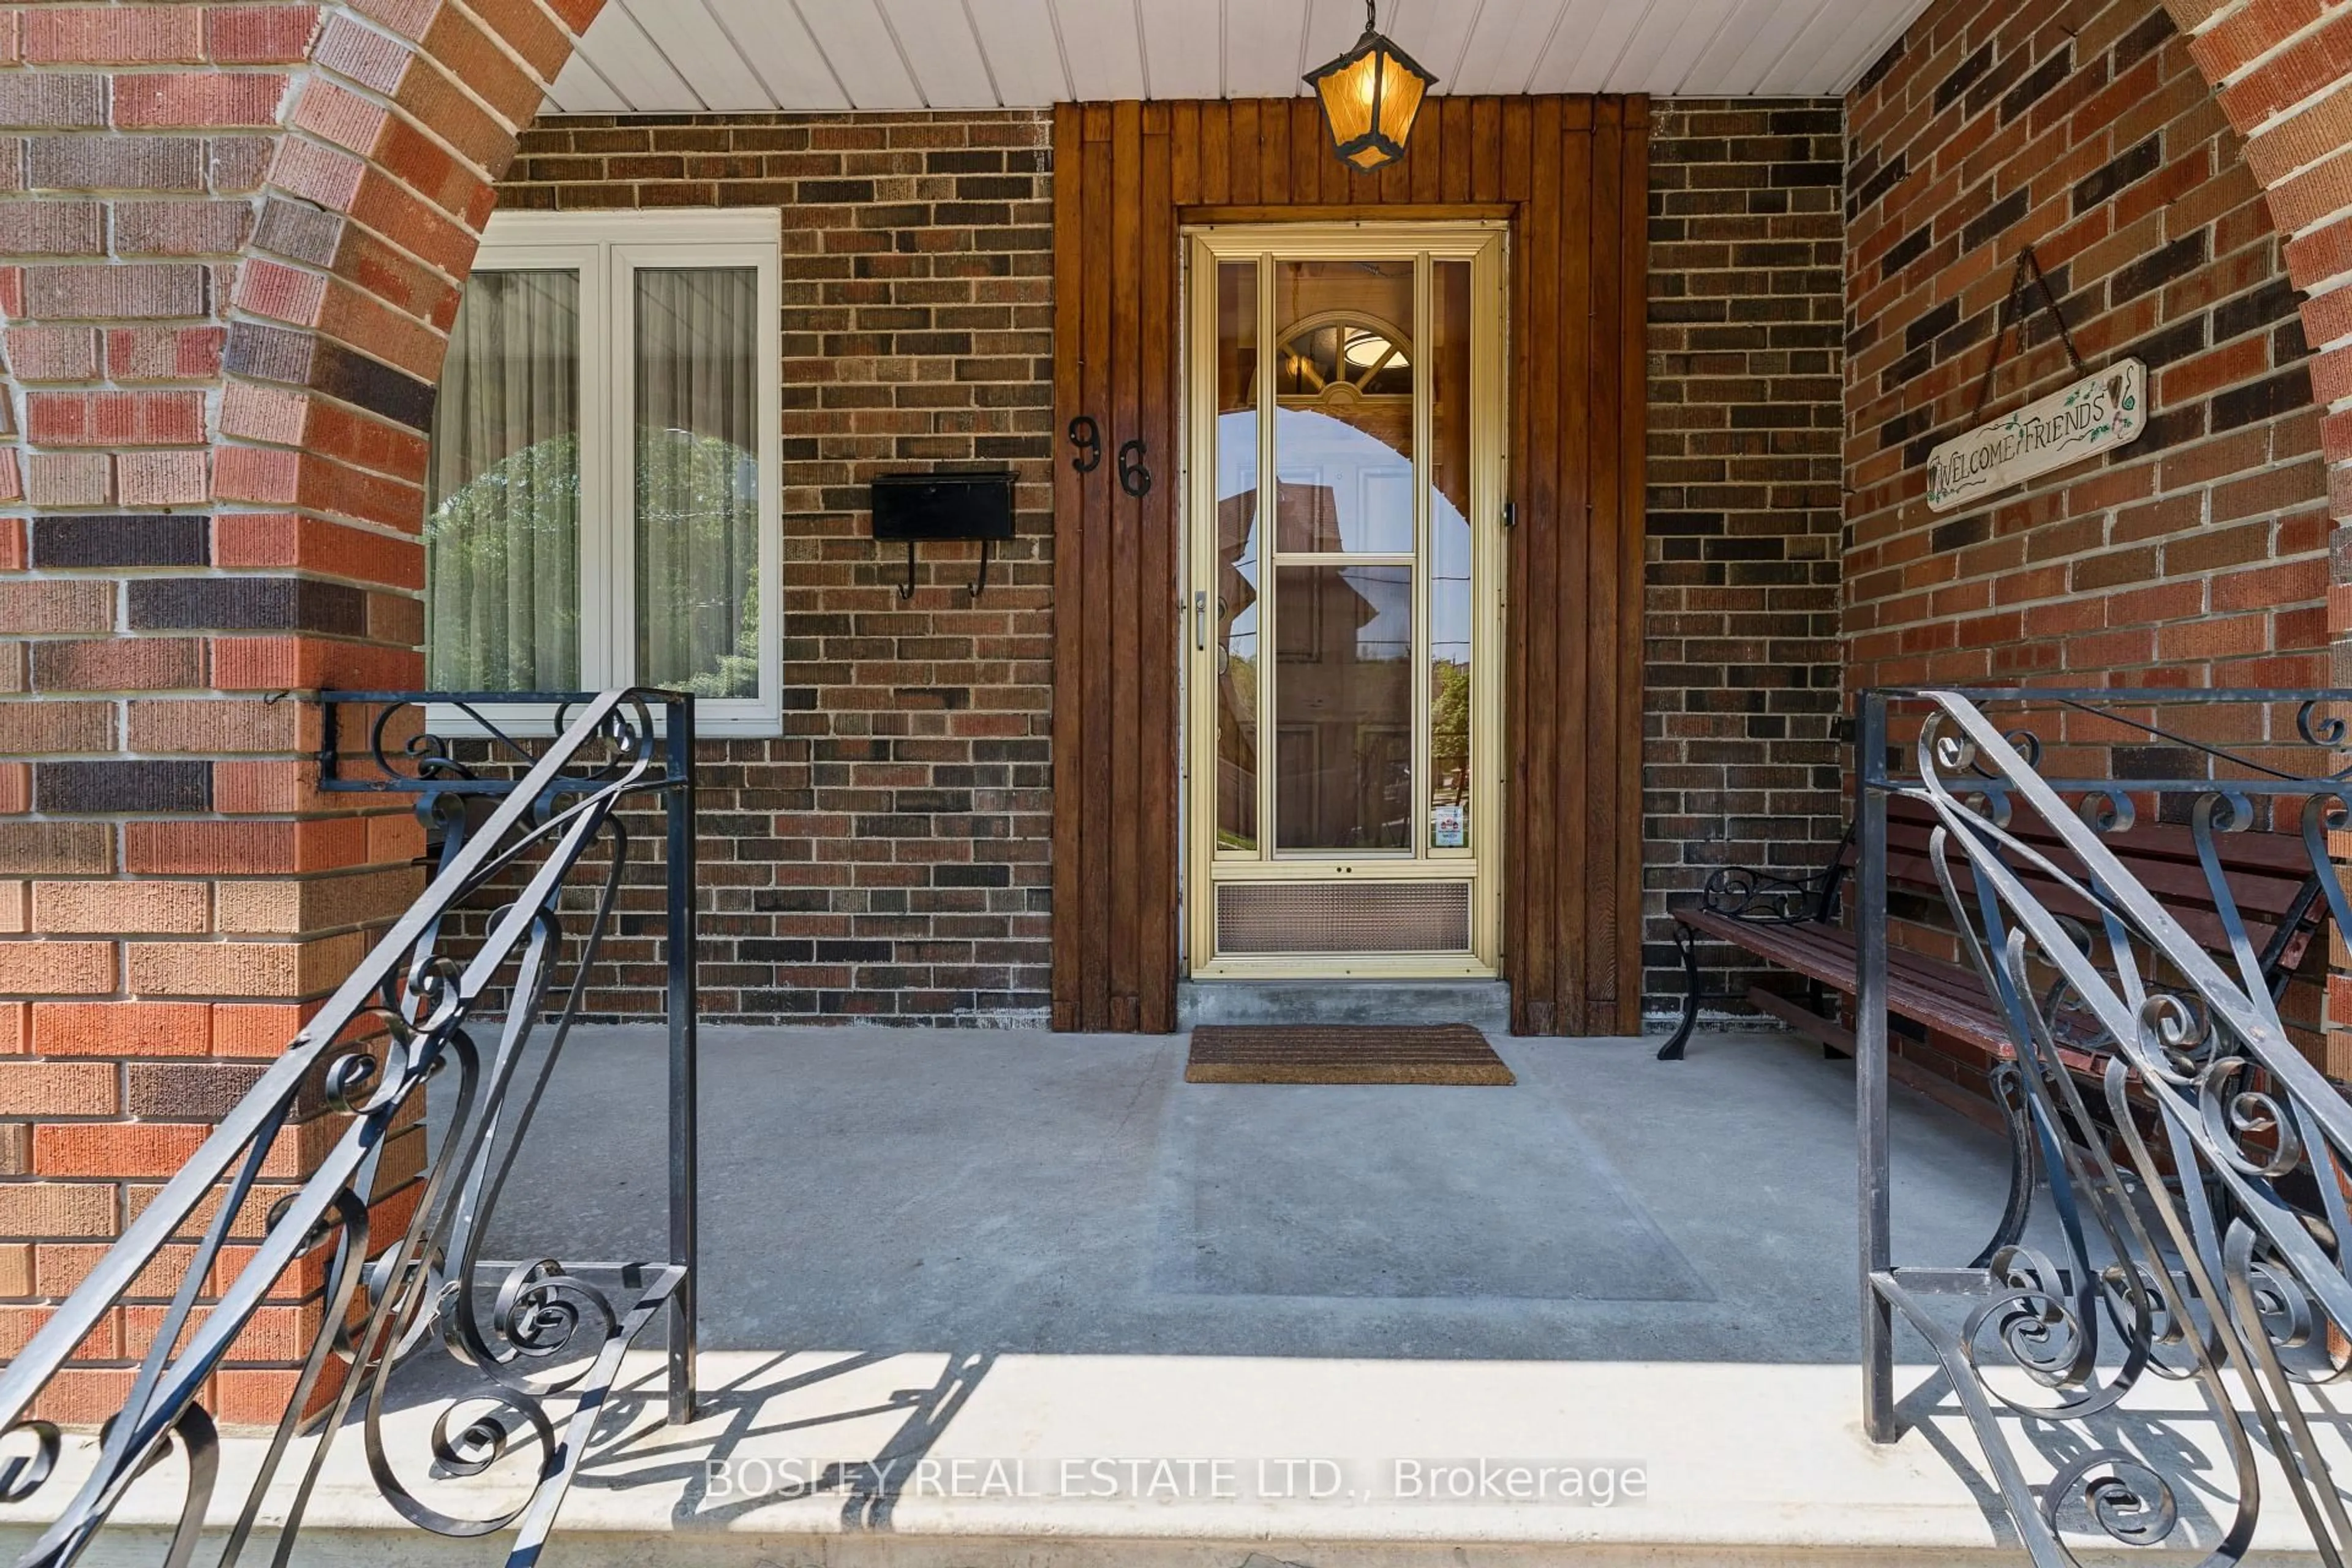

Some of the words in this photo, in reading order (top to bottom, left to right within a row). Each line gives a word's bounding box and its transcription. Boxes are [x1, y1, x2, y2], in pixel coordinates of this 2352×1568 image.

[1068, 416, 1152, 497] 96
[1940, 434, 2016, 486] WELCOME
[2022, 393, 2105, 453] FRIENDS
